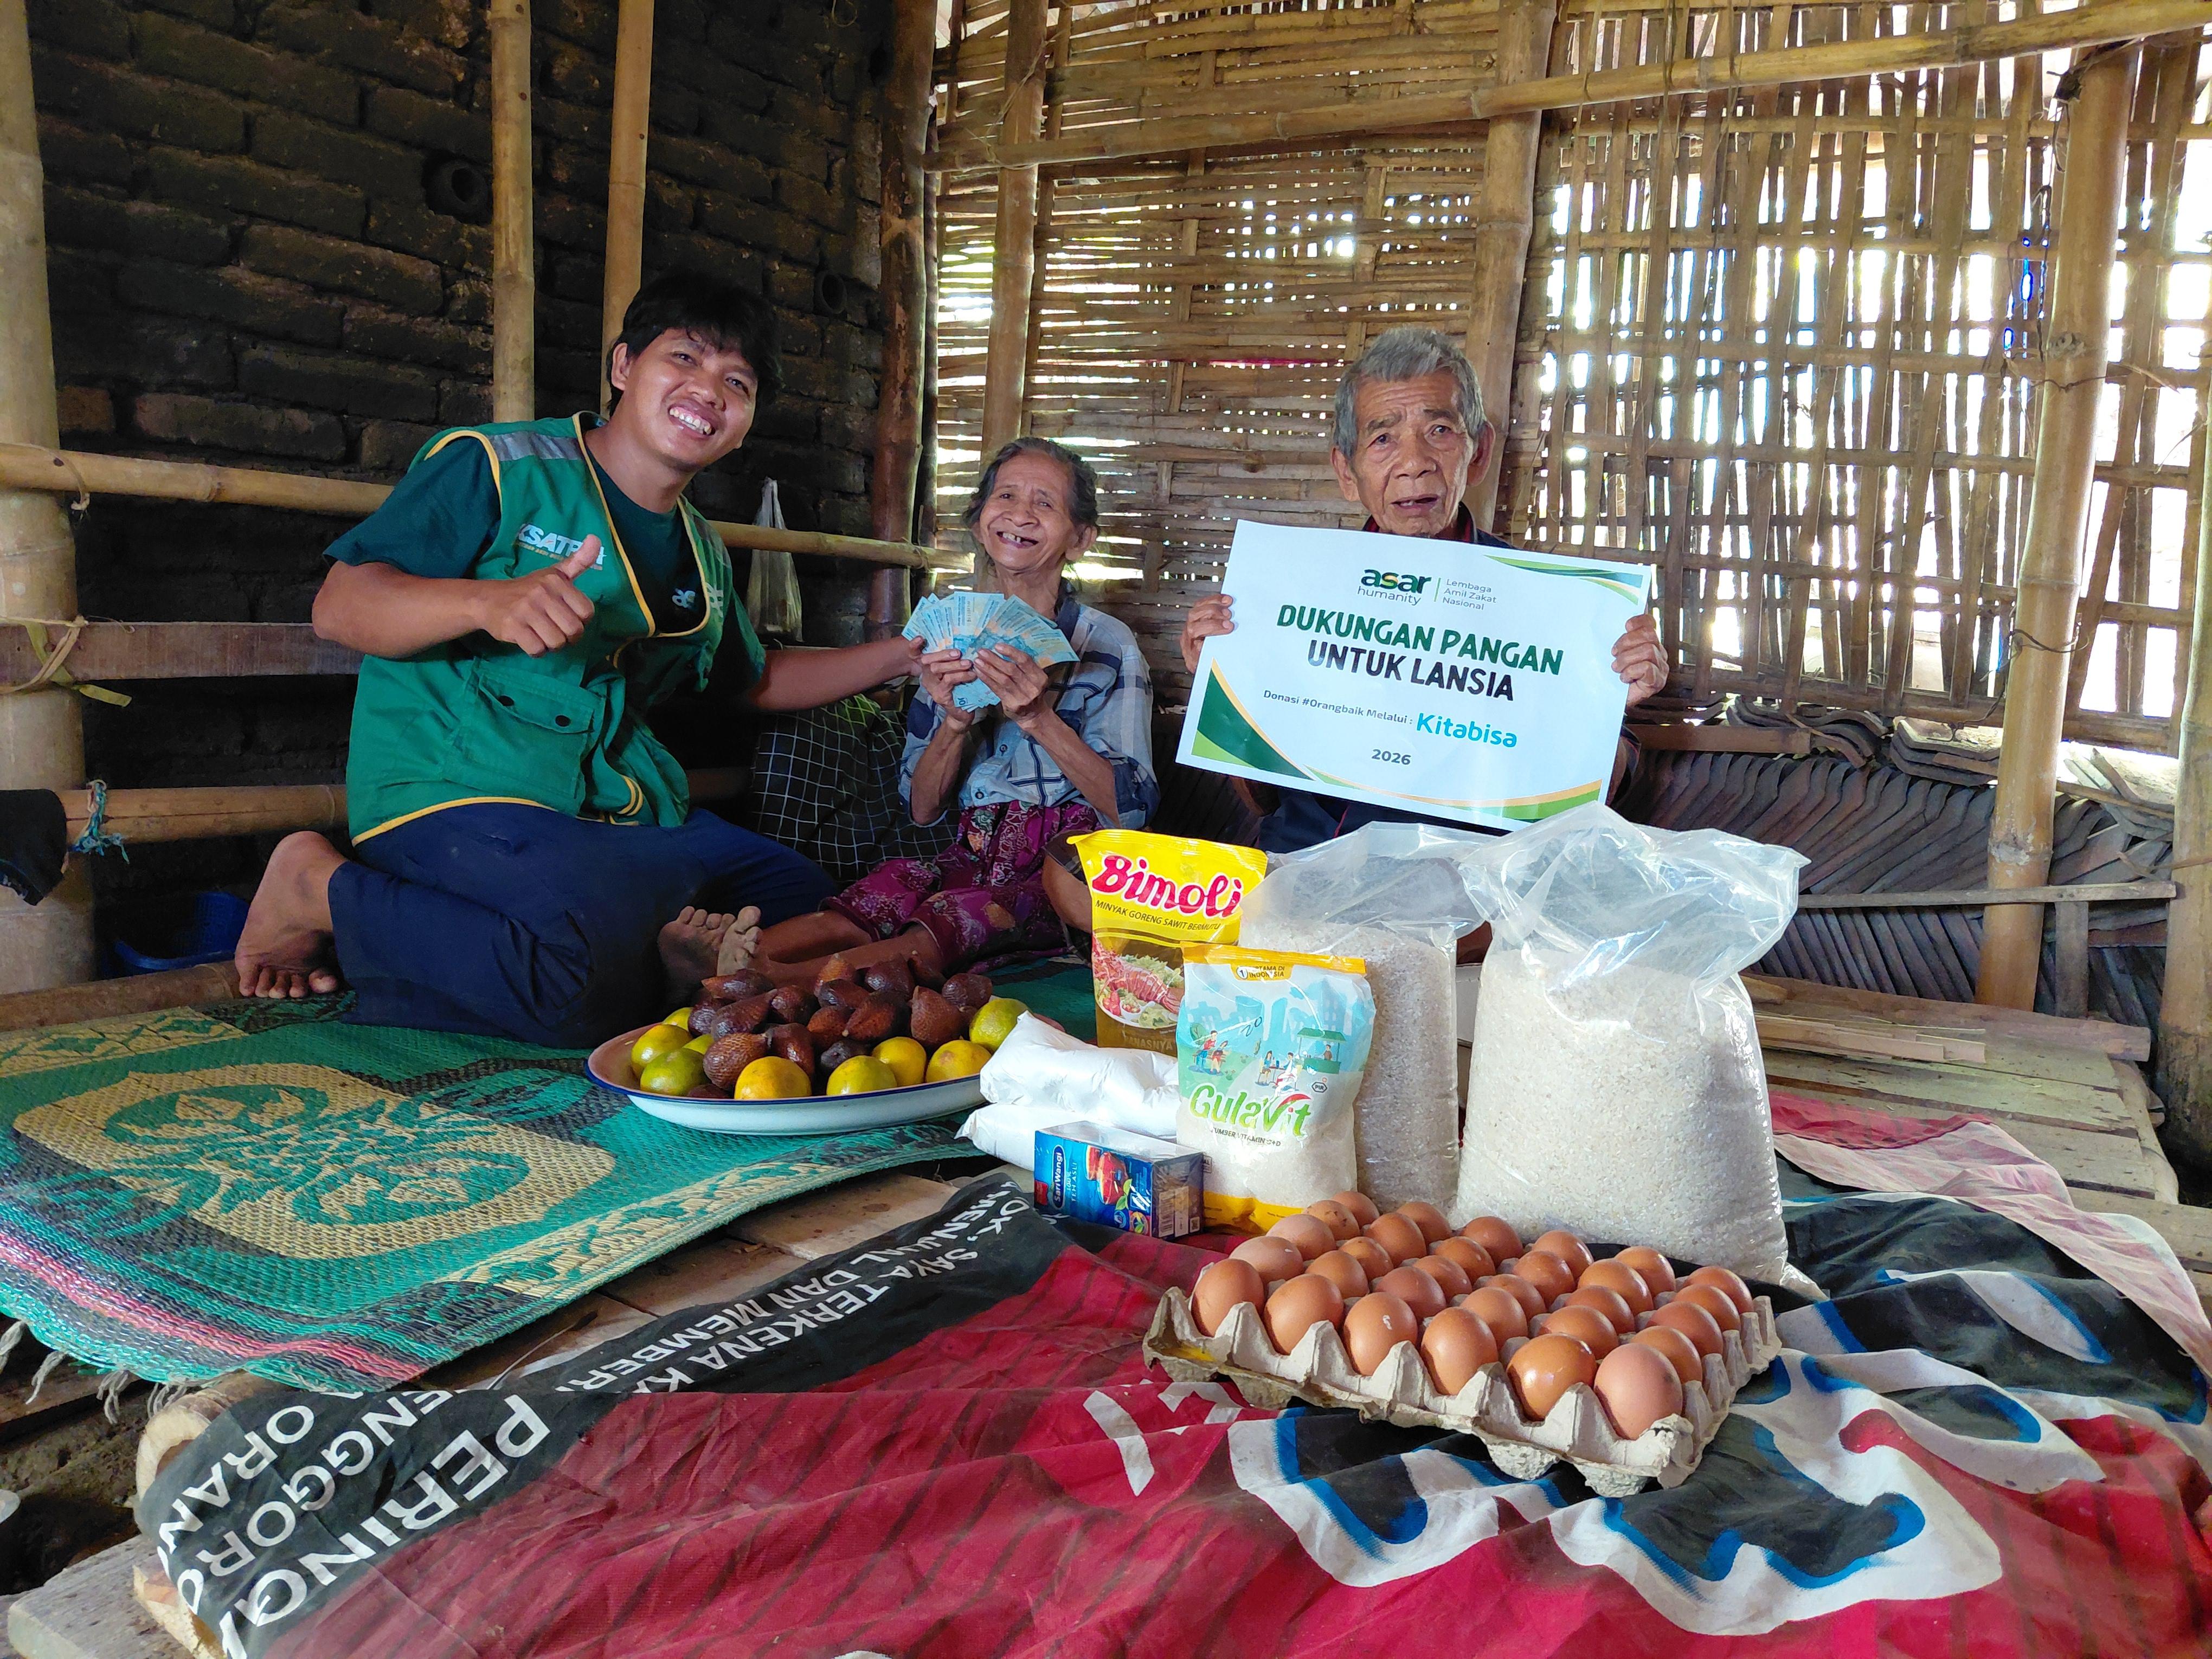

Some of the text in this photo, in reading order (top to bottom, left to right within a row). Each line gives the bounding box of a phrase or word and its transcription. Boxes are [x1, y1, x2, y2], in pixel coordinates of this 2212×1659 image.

[1357, 586, 1421, 606] humanity
[1361, 569, 1432, 594] asar
[1444, 588, 1497, 603] Amil Zakat
[1446, 578, 1491, 593] Lembaga
[1442, 597, 1484, 610] Nasional
[1276, 605, 1564, 675] DUKUNGAN PANGAN
[1307, 640, 1514, 702] UNTUK LANSIA
[1263, 690, 1300, 705] Donasi
[1302, 697, 1364, 716] #Orangbaik
[1366, 709, 1407, 725] Melalui
[1417, 712, 1517, 748] Kitabisa
[1371, 748, 1412, 766] 2026
[1091, 854, 1242, 917] Bimoli
[1096, 899, 1128, 916] MINYAK
[1128, 910, 1162, 924] GORENG
[1162, 918, 1187, 930] SAWIT
[1190, 1085, 1311, 1136] GulaVit
[1053, 1152, 1062, 1203] SariWangi
[877, 1248, 978, 1279] SAYA
[767, 1269, 862, 1309] DAN
[687, 1283, 891, 1371] TERKENA
[157, 1405, 314, 1576] ORAN
